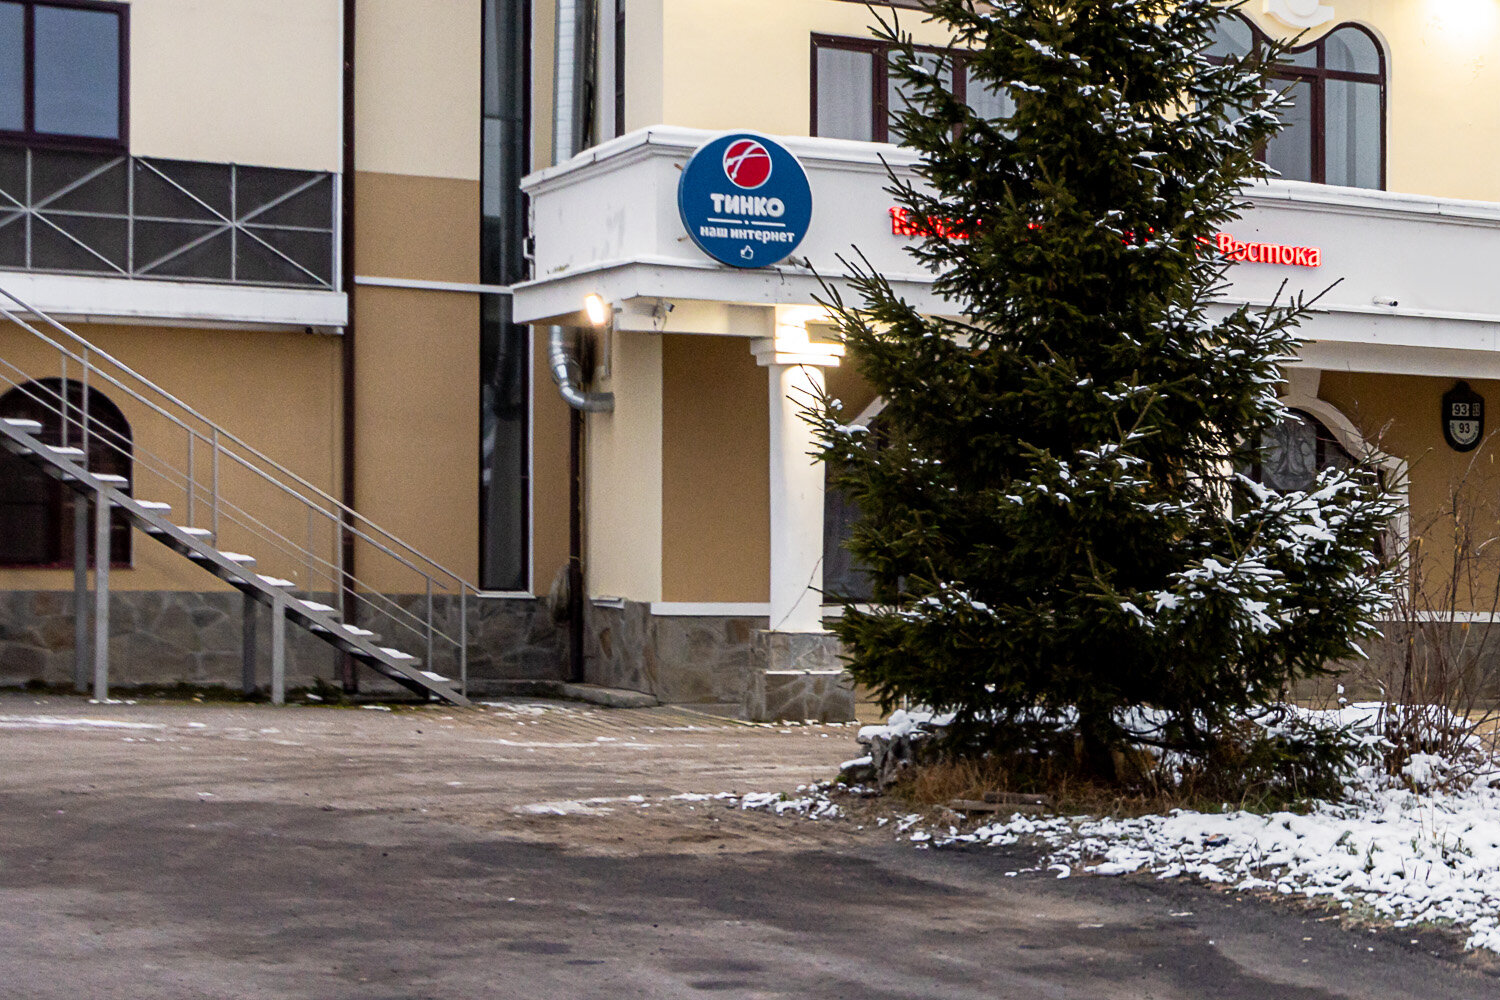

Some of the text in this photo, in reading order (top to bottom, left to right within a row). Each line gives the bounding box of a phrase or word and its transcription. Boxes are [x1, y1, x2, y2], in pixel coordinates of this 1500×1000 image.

[710, 193, 785, 218] ТИНКО
[700, 226, 795, 244] наш интернет
[1216, 233, 1321, 267] Востока
[1454, 404, 1468, 415] 93
[1459, 422, 1471, 434] 93
